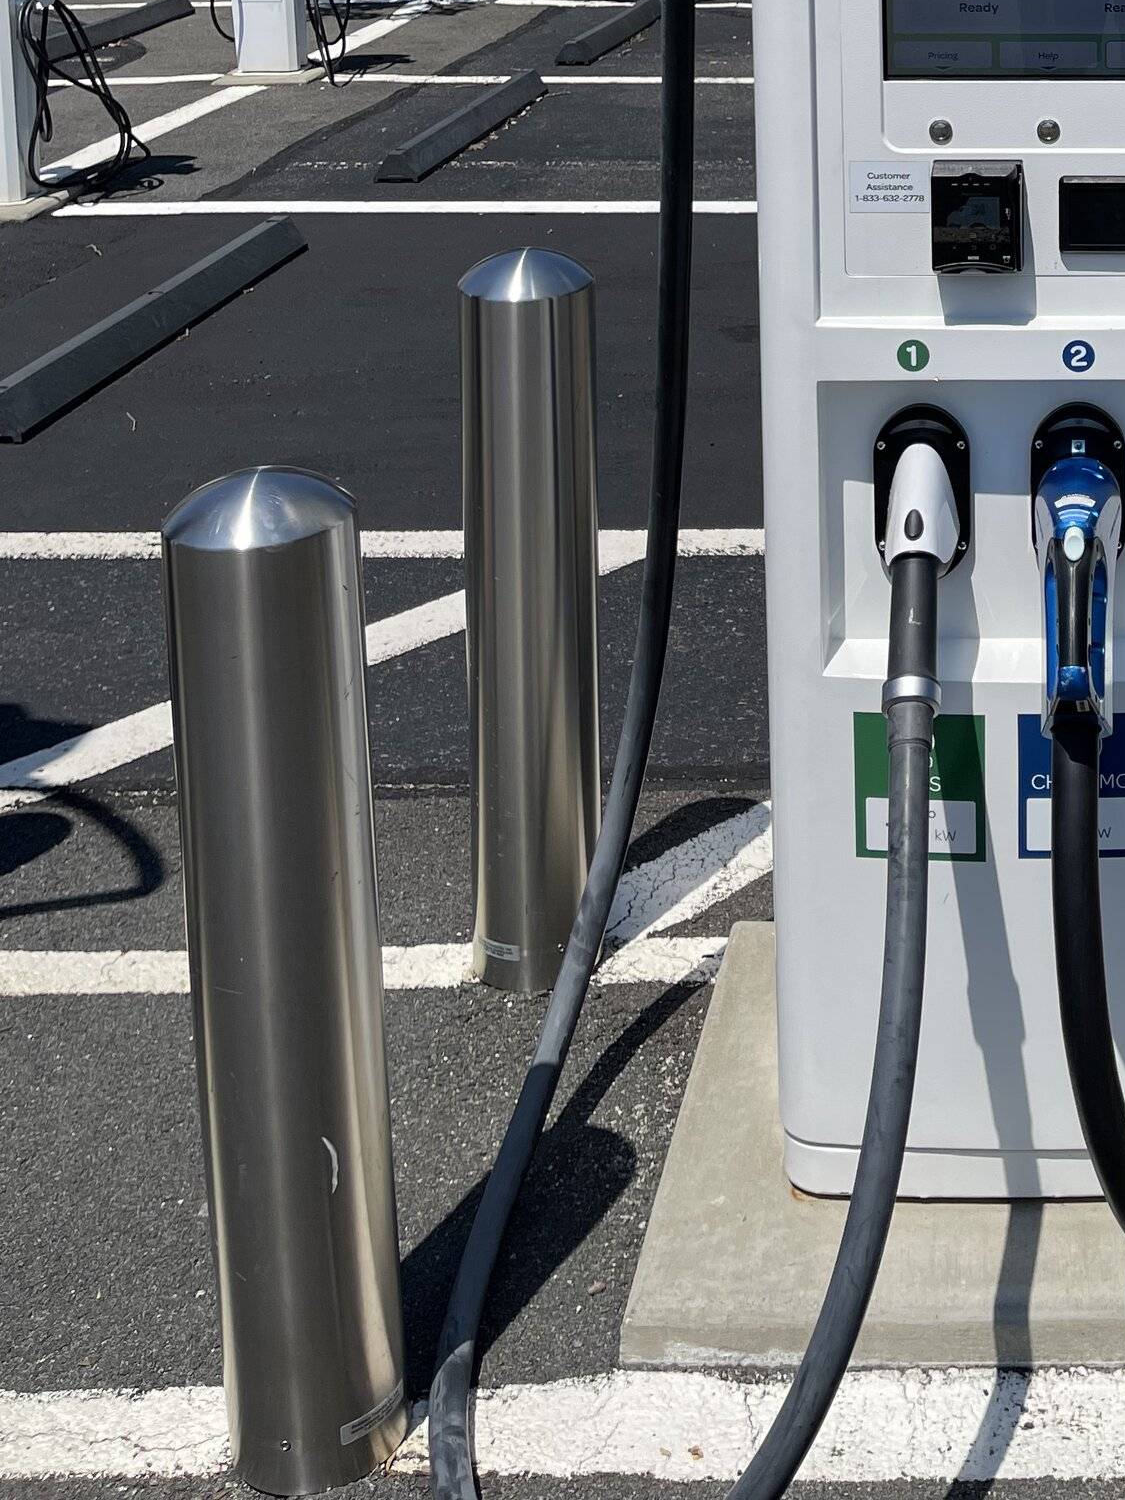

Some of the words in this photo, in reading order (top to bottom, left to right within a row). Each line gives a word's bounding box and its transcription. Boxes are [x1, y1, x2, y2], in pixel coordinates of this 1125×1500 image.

[959, 3, 999, 14] Ready
[927, 51, 959, 62] Pricing
[1038, 51, 1059, 61] Help
[866, 172, 910, 180] Customer
[866, 183, 914, 191] Assistance
[855, 194, 925, 202] 1-833-632-2778
[906, 345, 917, 367] 1
[1070, 345, 1088, 367] 2
[934, 829, 957, 842] kW
